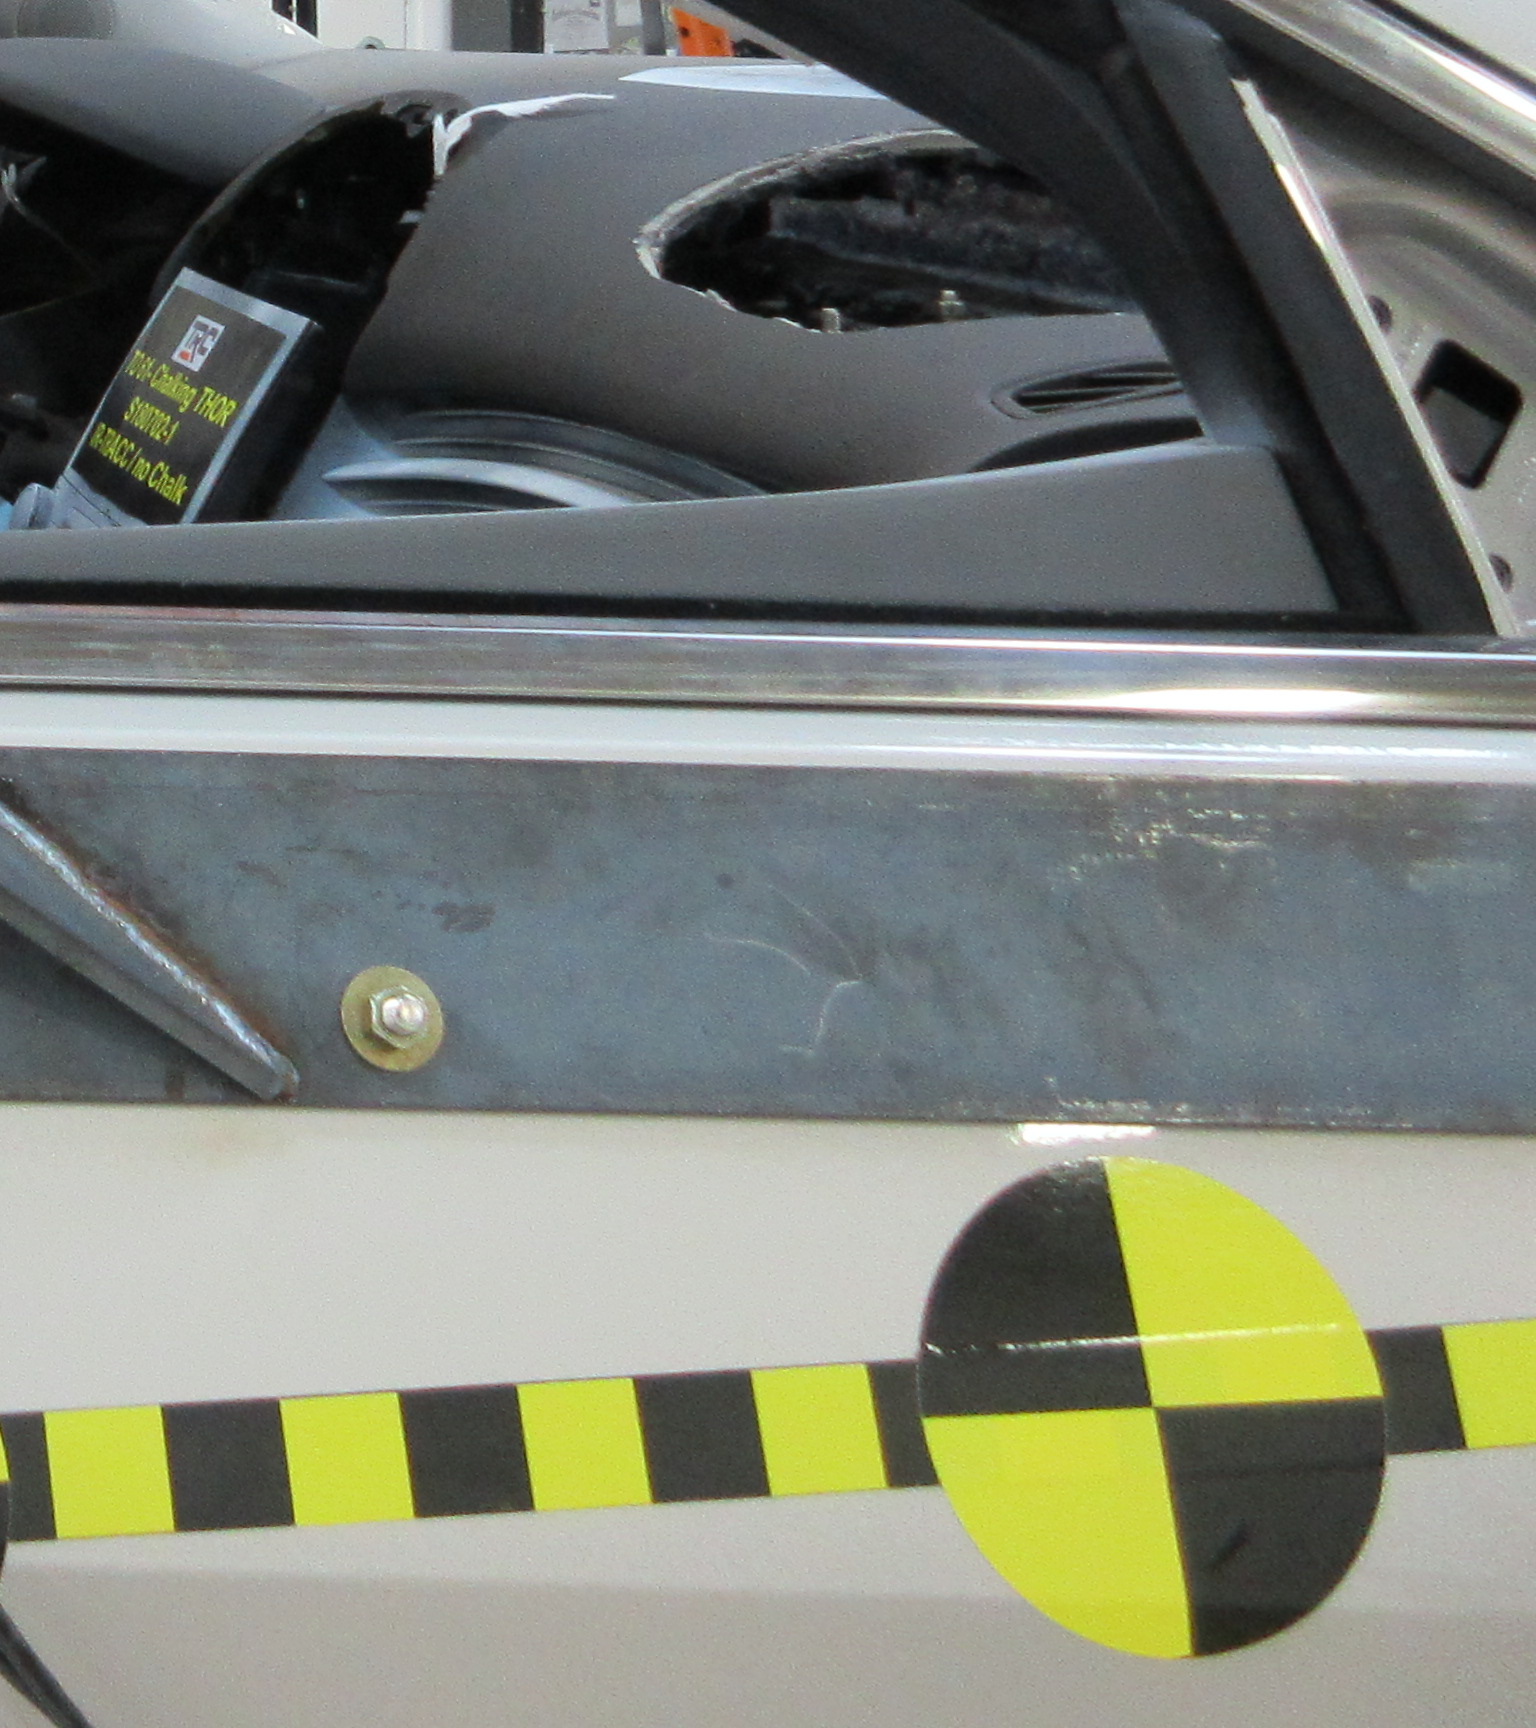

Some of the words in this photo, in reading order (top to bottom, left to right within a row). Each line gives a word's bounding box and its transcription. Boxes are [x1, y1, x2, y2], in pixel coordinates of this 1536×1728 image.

[193, 385, 238, 428] THOR
[131, 457, 151, 482] no
[148, 461, 188, 506] Chalk
